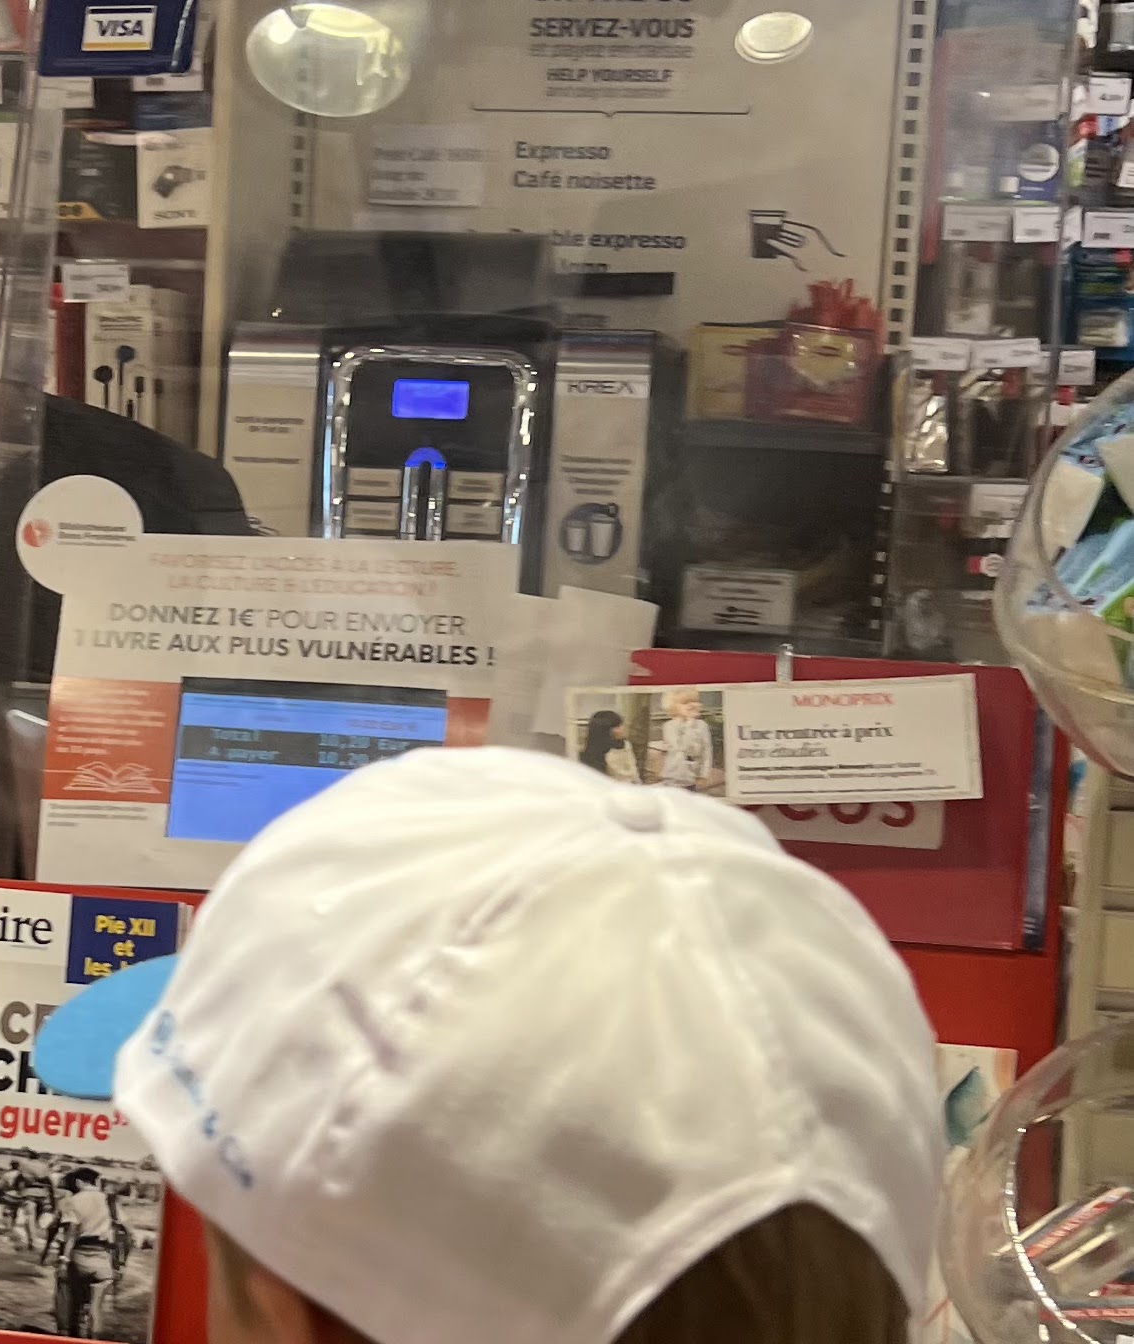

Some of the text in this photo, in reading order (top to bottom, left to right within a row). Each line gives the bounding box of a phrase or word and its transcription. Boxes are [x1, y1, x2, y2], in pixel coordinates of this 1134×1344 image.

[95, 19, 145, 37] VISA
[528, 17, 696, 39] SERVEZ-VOUS
[514, 141, 611, 163] Expresso
[566, 171, 658, 191] noisette
[108, 603, 219, 627] DONNEZ
[266, 608, 336, 632] POUR
[345, 611, 467, 637] ENVOYER
[93, 629, 162, 650] LIVRE
[166, 635, 219, 655] AUX
[228, 636, 290, 658] PLUS
[298, 635, 479, 667] VULNÉRABLES
[94, 914, 127, 936] Pie
[112, 939, 136, 958] et
[83, 957, 114, 977] les
